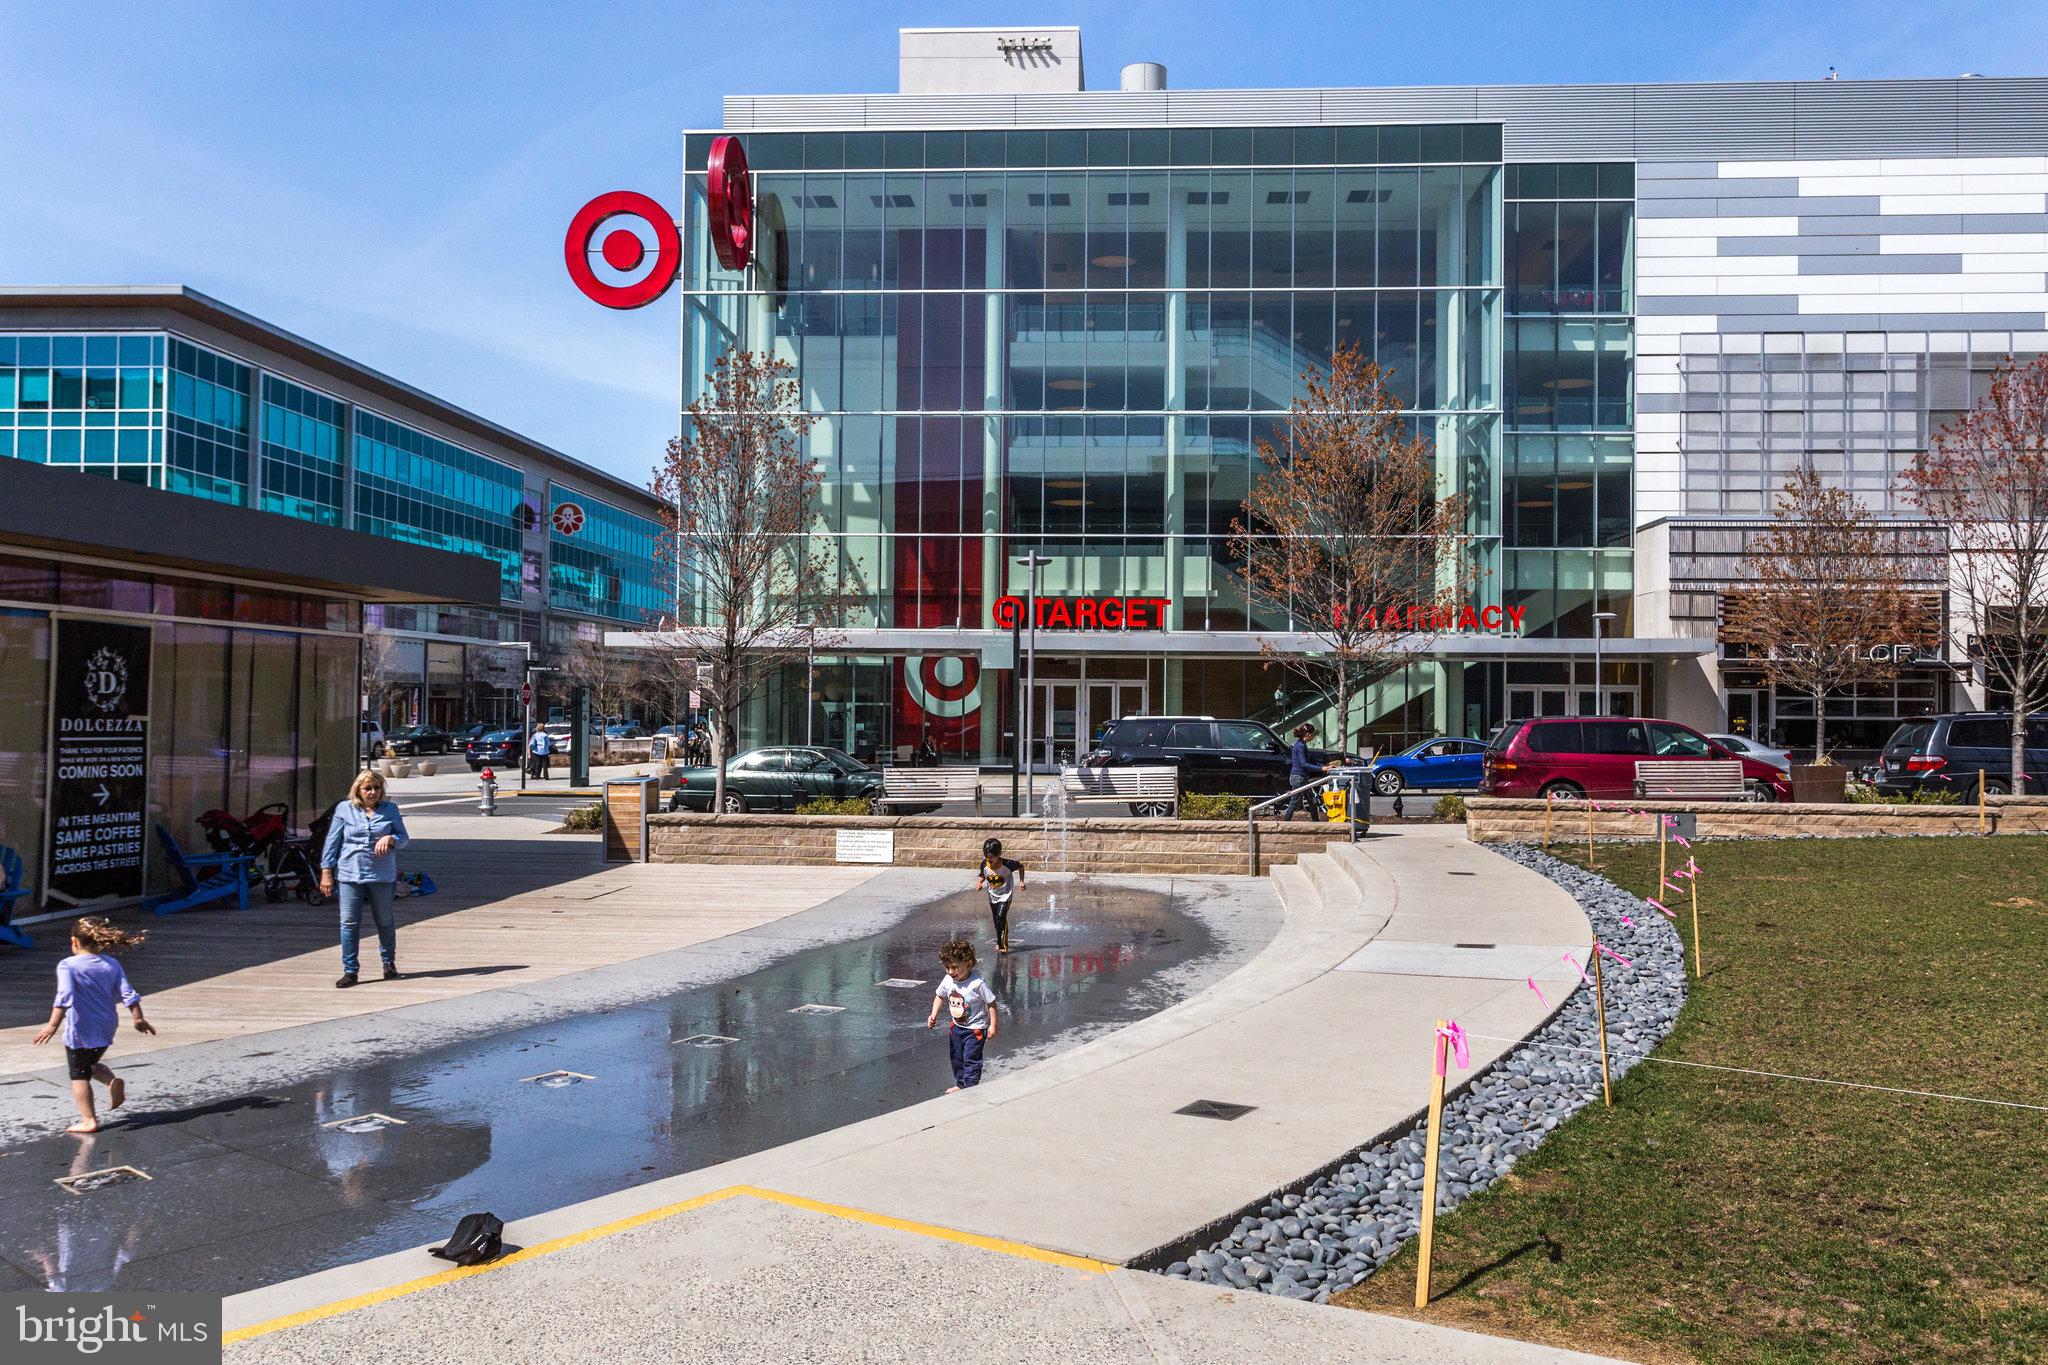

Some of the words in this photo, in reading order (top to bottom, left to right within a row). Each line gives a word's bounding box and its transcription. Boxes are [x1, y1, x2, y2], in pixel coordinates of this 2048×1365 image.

[1034, 598, 1171, 628] TARGET
[60, 718, 143, 732] DOLCEZZA
[58, 765, 108, 779] COMING
[110, 764, 143, 777] SOON
[57, 816, 69, 828] IN
[71, 815, 90, 826] THE
[92, 812, 141, 825] MEANTIME
[56, 829, 92, 845] SAME
[95, 825, 141, 841] COFFEE
[55, 846, 88, 861] SAME
[89, 841, 141, 857] PASTRIES
[54, 862, 92, 875] ACROSS
[93, 859, 108, 871] THE
[109, 856, 140, 868] STREET
